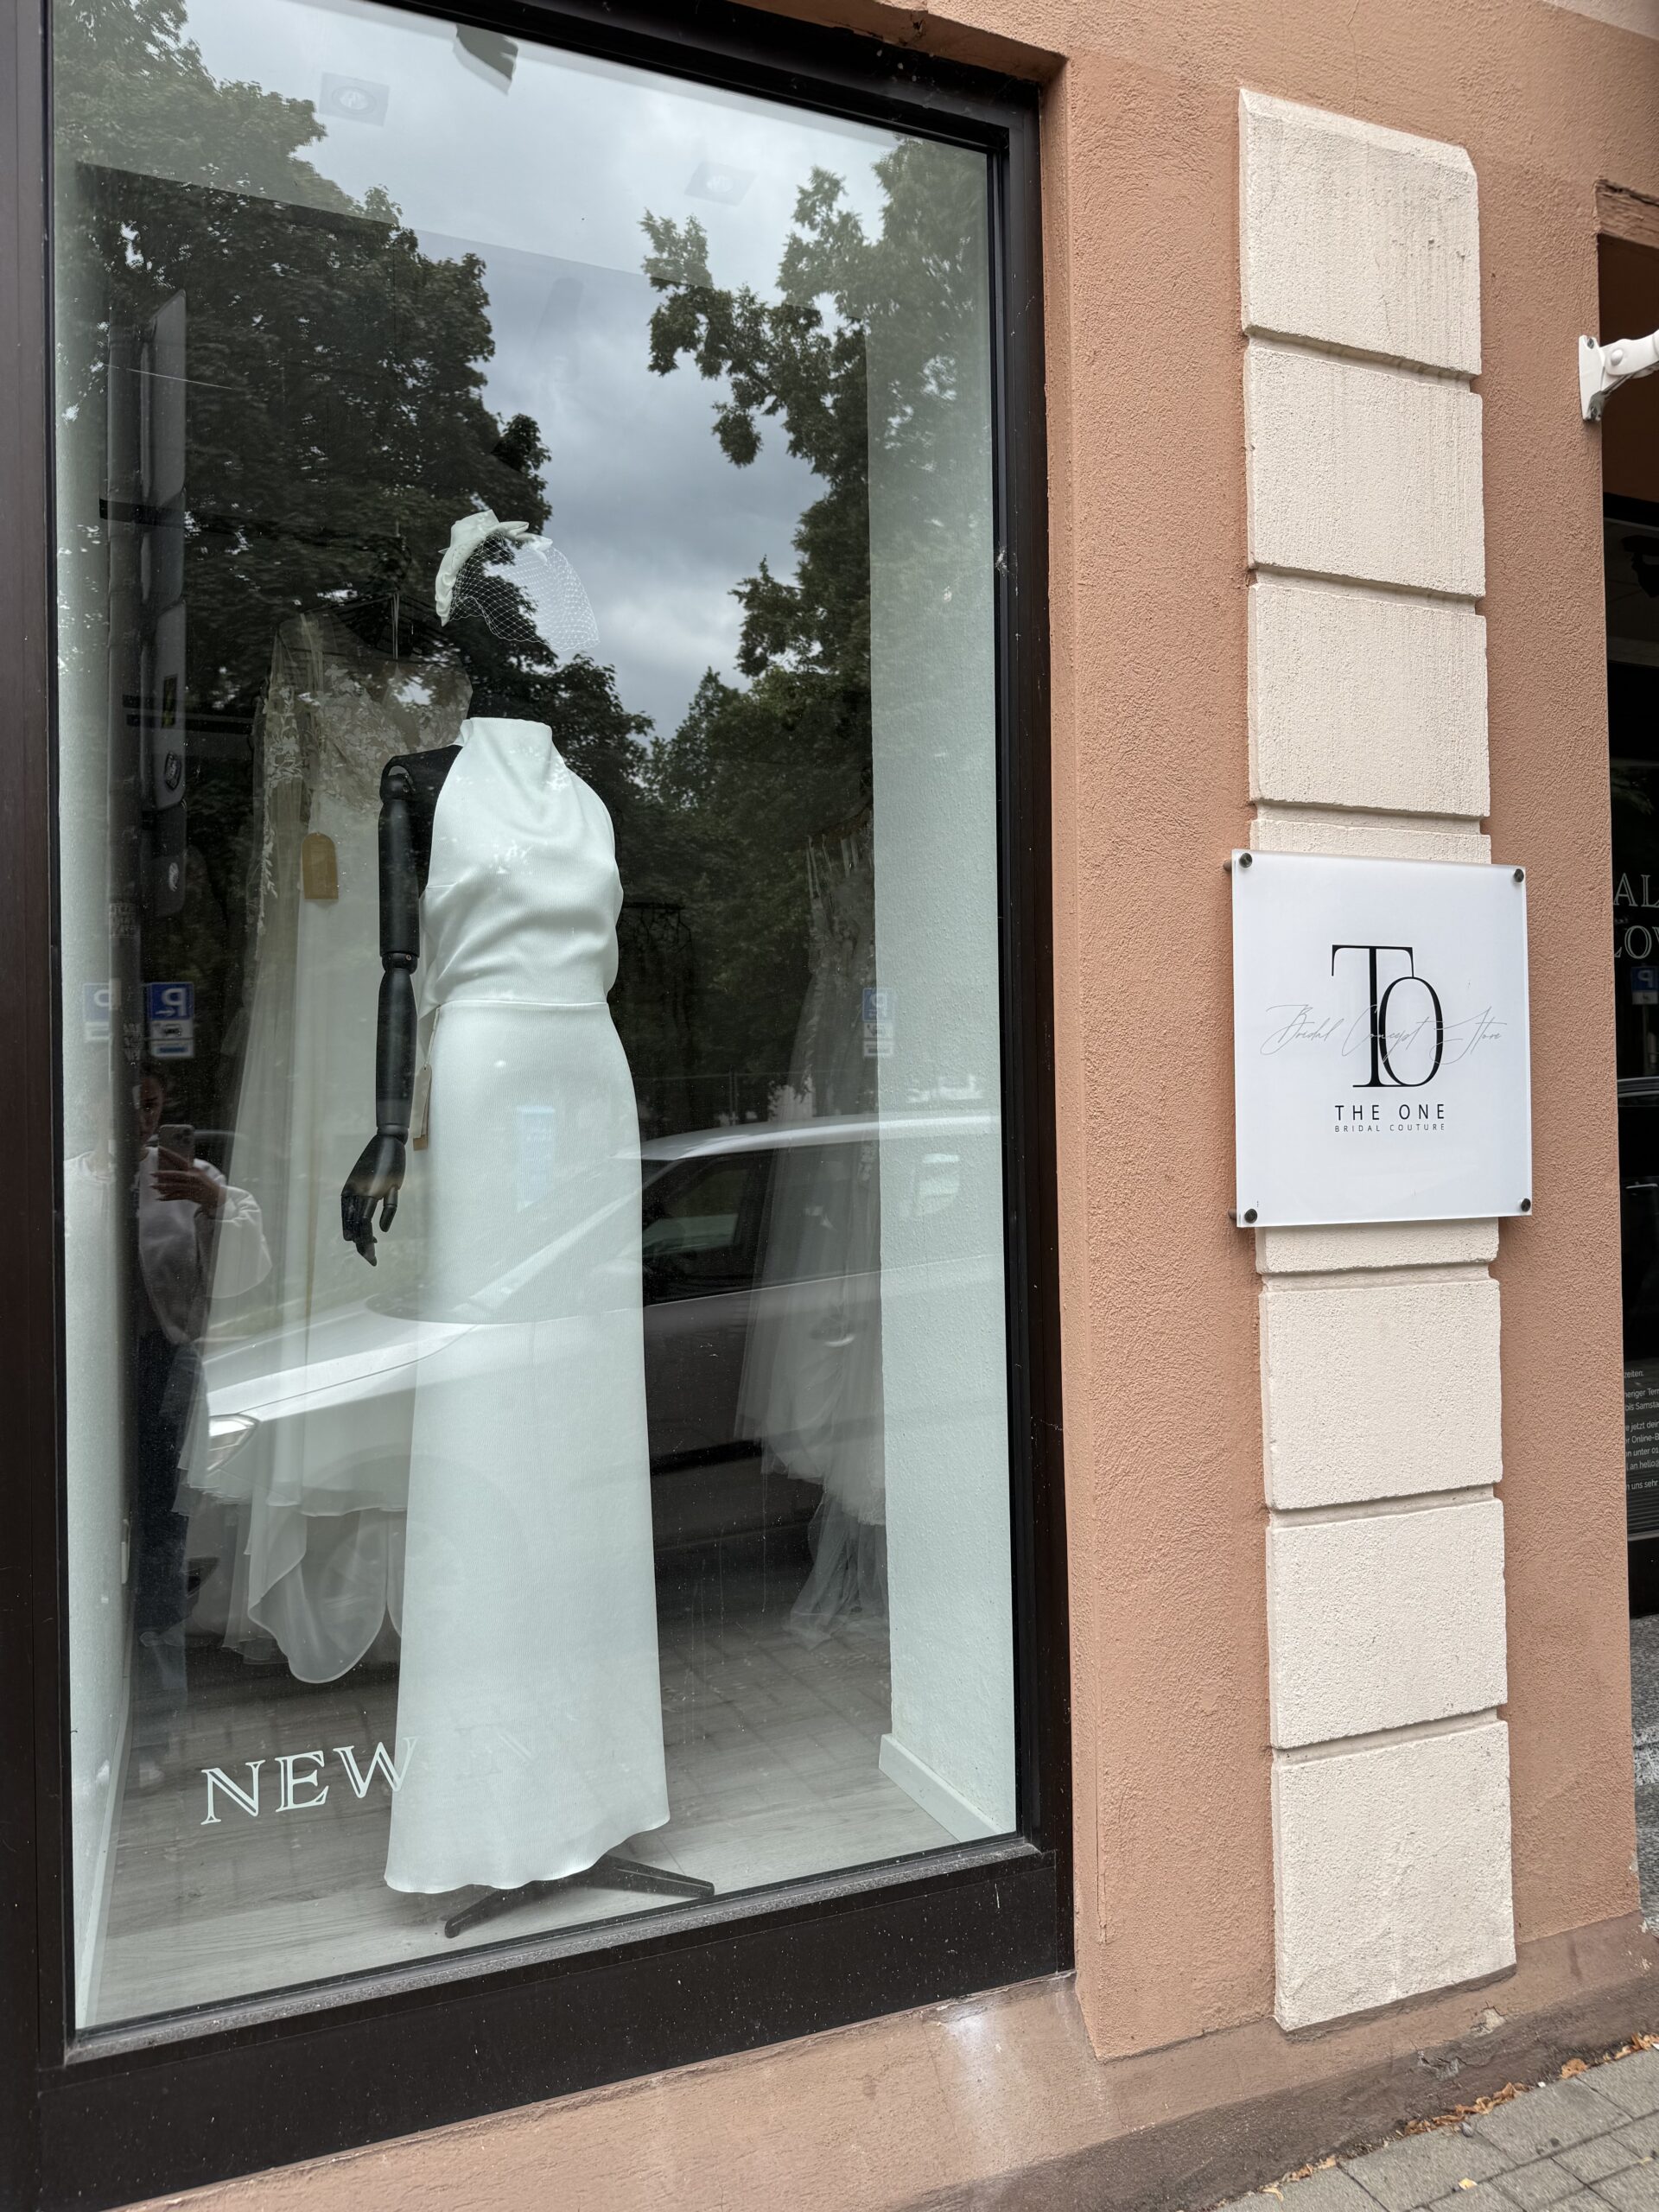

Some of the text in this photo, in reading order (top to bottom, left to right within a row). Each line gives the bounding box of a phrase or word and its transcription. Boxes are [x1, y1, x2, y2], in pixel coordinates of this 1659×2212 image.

[1260, 1004, 1344, 1055] Bridal
[1429, 1006, 1508, 1065] Store
[1334, 1103, 1445, 1121] THE ONE
[200, 1736, 419, 1826] NEW
